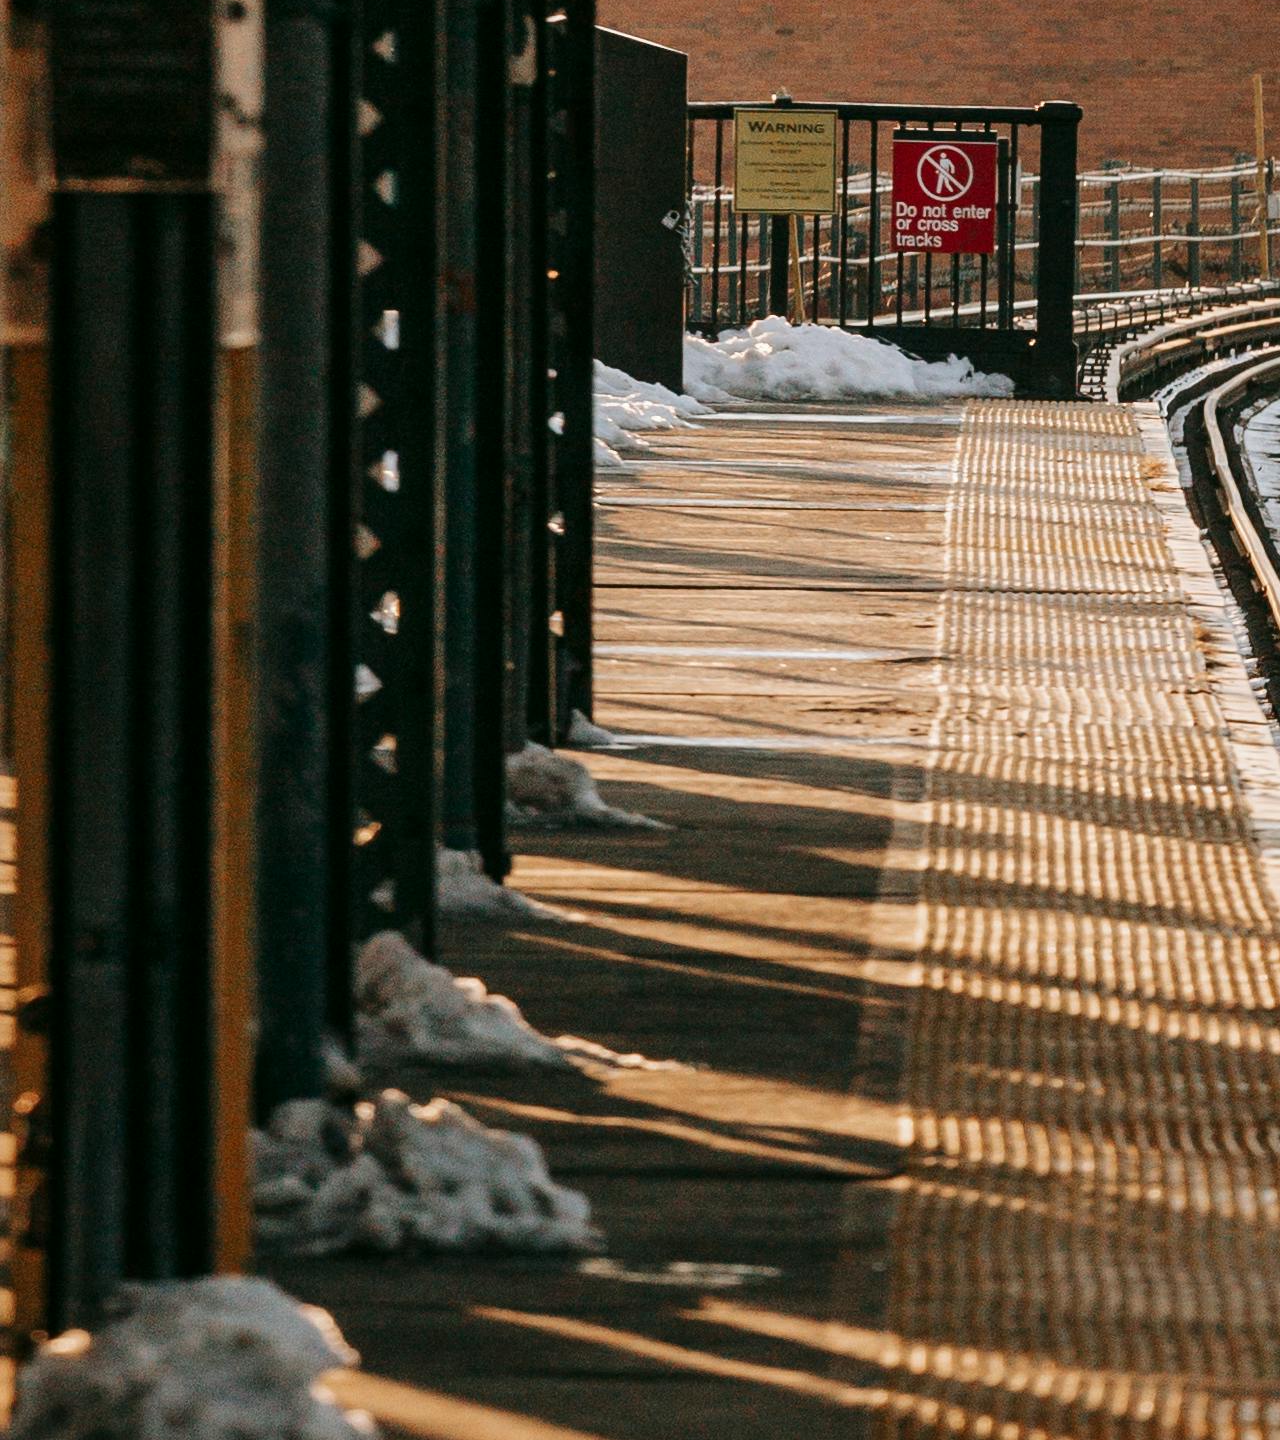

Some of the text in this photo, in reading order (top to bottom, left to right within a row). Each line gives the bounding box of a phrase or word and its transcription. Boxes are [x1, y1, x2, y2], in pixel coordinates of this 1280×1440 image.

[748, 121, 824, 133] WARNING
[896, 202, 991, 219] Do not enter
[896, 218, 959, 232] or cross
[896, 232, 942, 247] tracks
